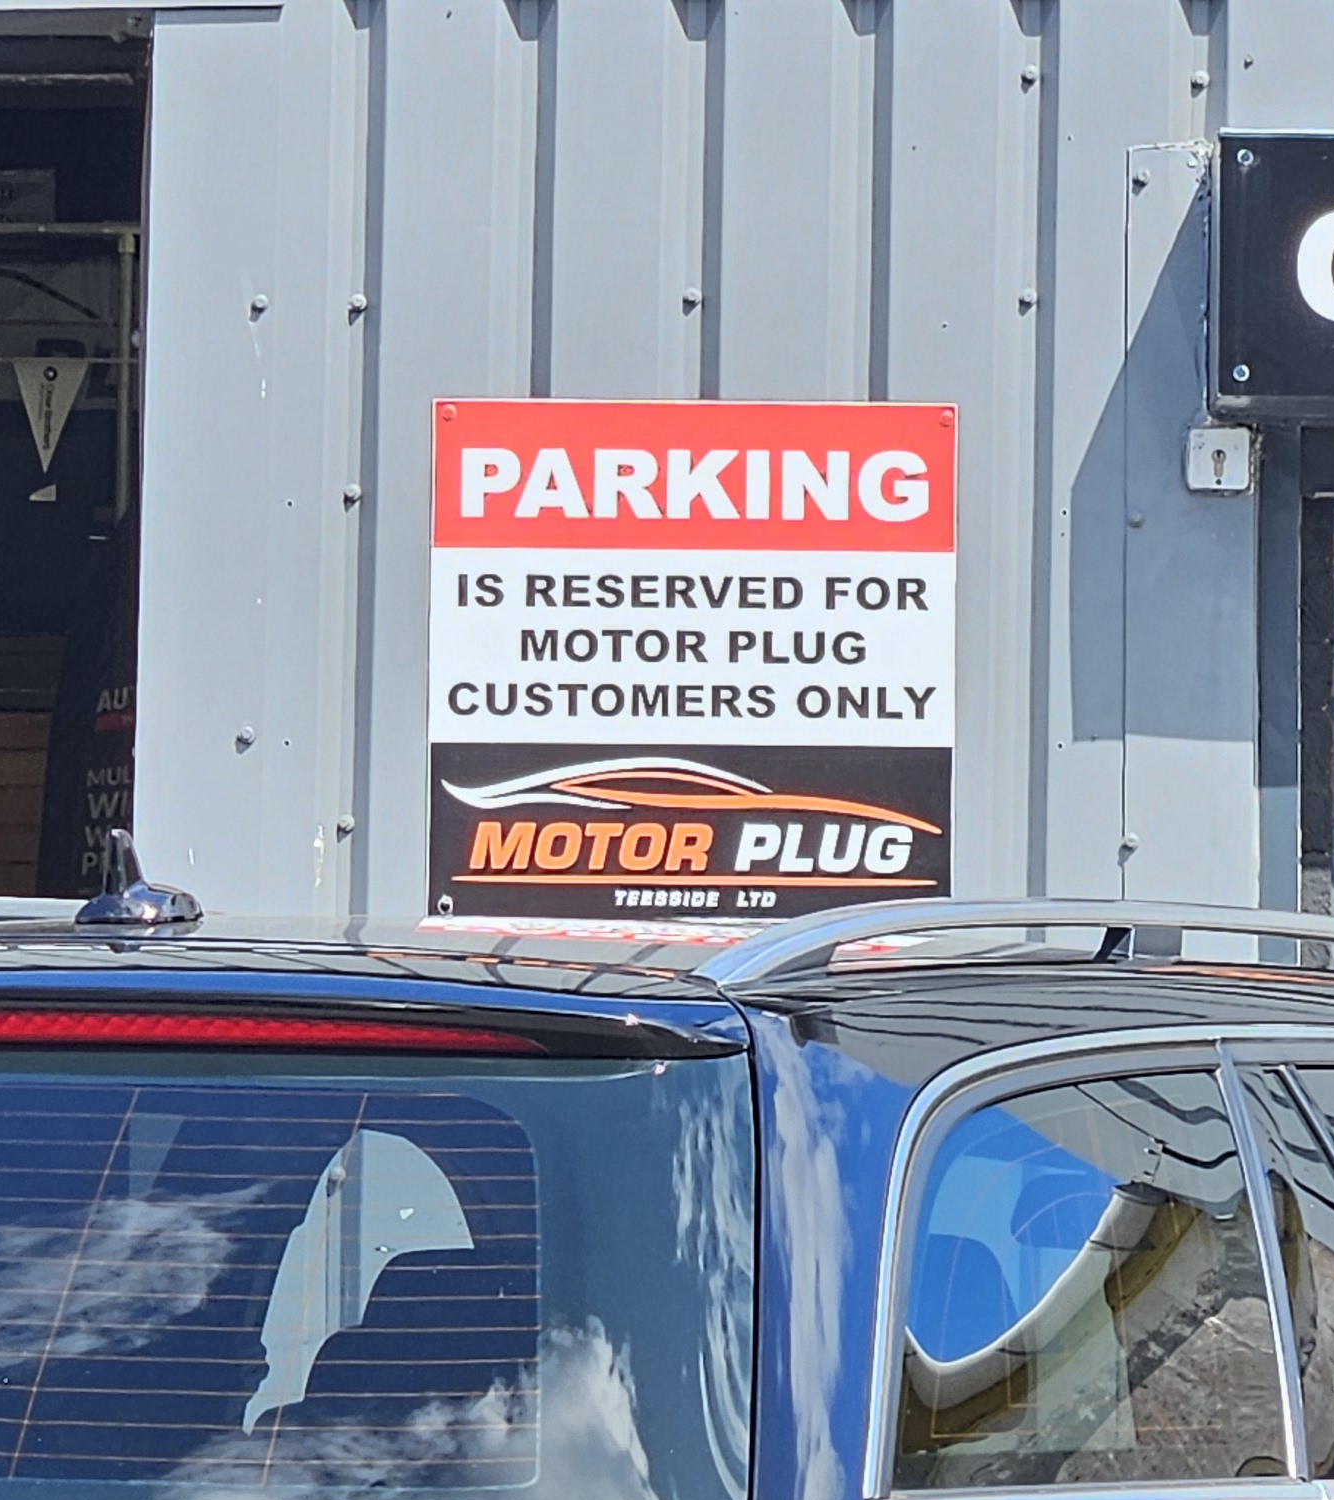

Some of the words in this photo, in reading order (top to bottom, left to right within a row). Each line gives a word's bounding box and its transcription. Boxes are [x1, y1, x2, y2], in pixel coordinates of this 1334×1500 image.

[460, 447, 930, 523] PARKING
[458, 573, 505, 608] IS
[525, 574, 804, 610] RESERVED
[825, 576, 929, 611] FOR
[520, 629, 708, 664] MOTOR
[729, 630, 867, 665] PLUG
[448, 682, 777, 719] CUSTOMERS
[796, 685, 937, 721] ONLY
[470, 822, 714, 872] MOTOR
[734, 825, 913, 875] PLUG
[614, 889, 720, 907] TEESSIDE
[735, 890, 777, 908] LTD
